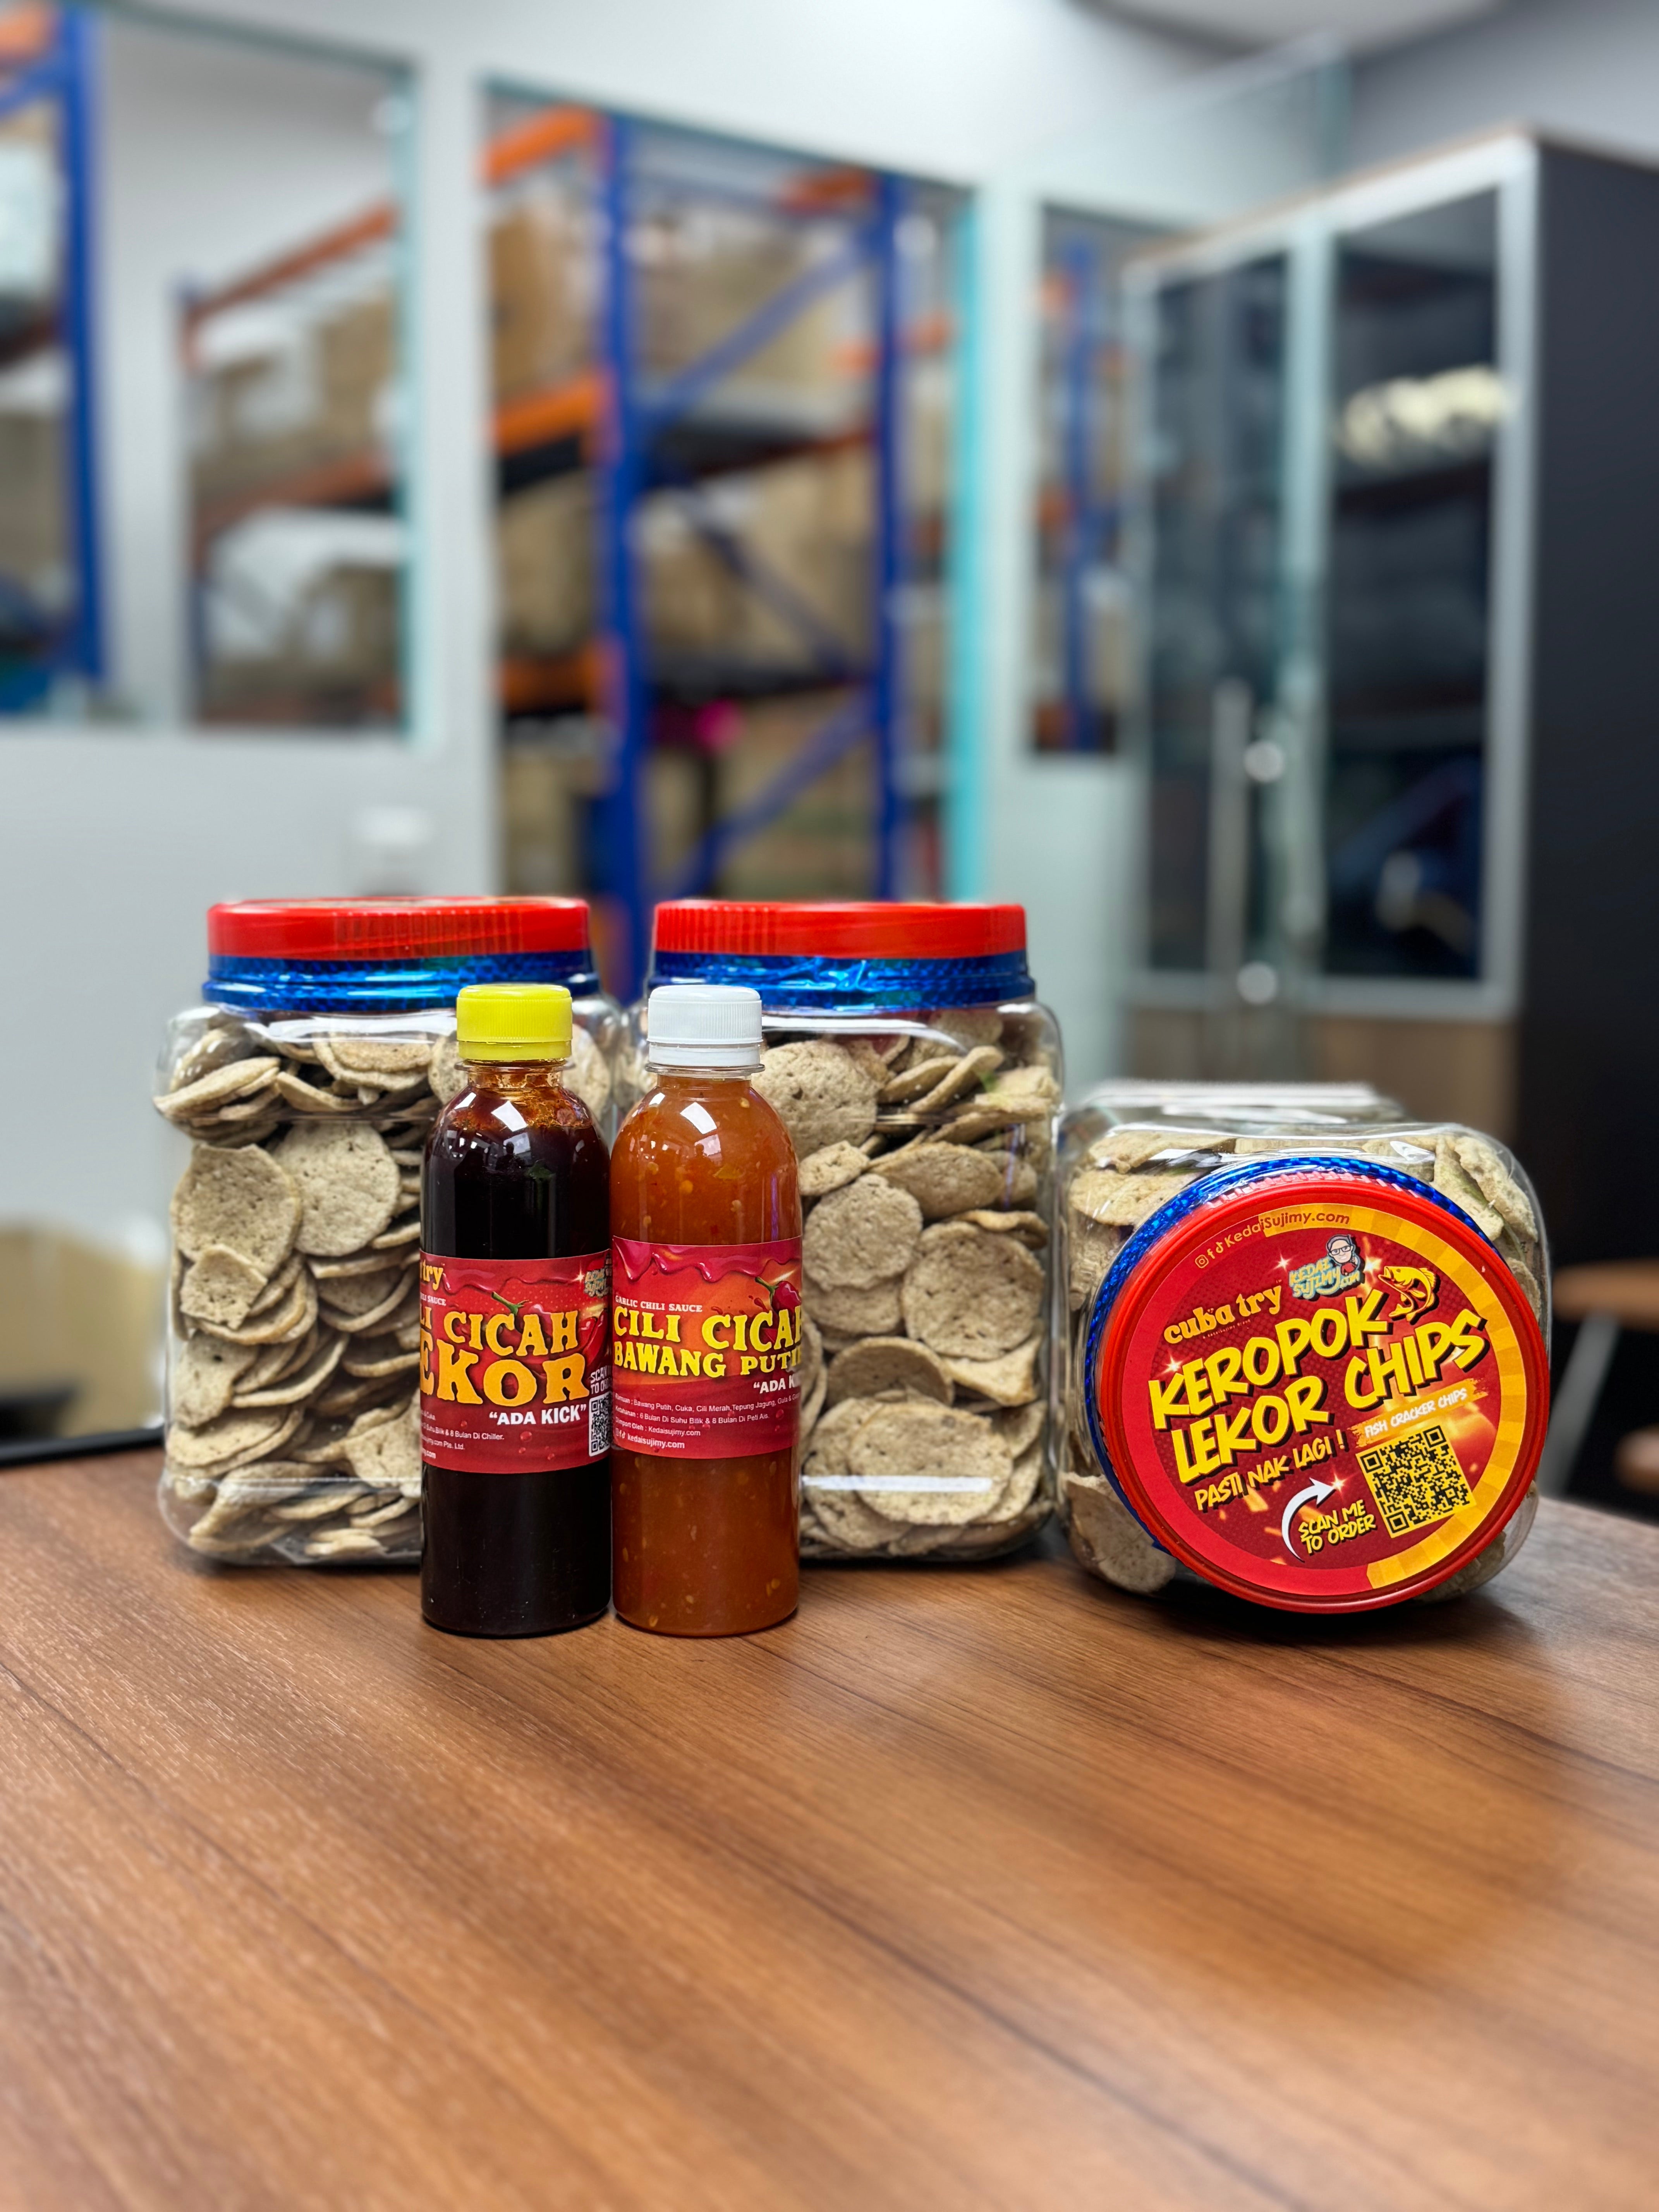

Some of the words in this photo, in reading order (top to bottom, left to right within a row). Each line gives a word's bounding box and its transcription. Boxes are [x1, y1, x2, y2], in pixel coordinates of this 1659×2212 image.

[1224, 1212, 1350, 1247] KedaiSujimy.com
[427, 1295, 447, 1306] SAUCE
[615, 1295, 638, 1307] GARLIC
[640, 1301, 665, 1310] CHILI
[669, 1304, 703, 1312] SAUCE
[1164, 1305, 1235, 1344] cuba
[1236, 1285, 1281, 1317] try
[444, 1310, 578, 1355] CICAH
[614, 1306, 681, 1342] CILI
[614, 1341, 726, 1378] BAWANG
[1149, 1289, 1388, 1429] KEROPOK
[591, 1382, 599, 1394] TO
[634, 1399, 654, 1410] Bawang
[756, 1400, 776, 1409] Jagung,
[1171, 1376, 1329, 1483] LEKOR
[1345, 1309, 1482, 1408] CHIPS
[644, 1413, 660, 1422] Bulan
[1364, 1419, 1388, 1438] FISH
[1390, 1400, 1436, 1427] CRACKER
[1438, 1388, 1467, 1408] CHIPS
[627, 1433, 685, 1449] kedaisujimy.com
[648, 1426, 701, 1437] Kedaisujimy.com
[1195, 1472, 1243, 1510] PASTI
[1247, 1455, 1289, 1487] NAK
[1293, 1436, 1332, 1468] LAGI
[1298, 1510, 1338, 1539] SCAN
[1341, 1499, 1365, 1522] ME
[1301, 1535, 1323, 1554] TO
[1328, 1514, 1376, 1544] ORDER
